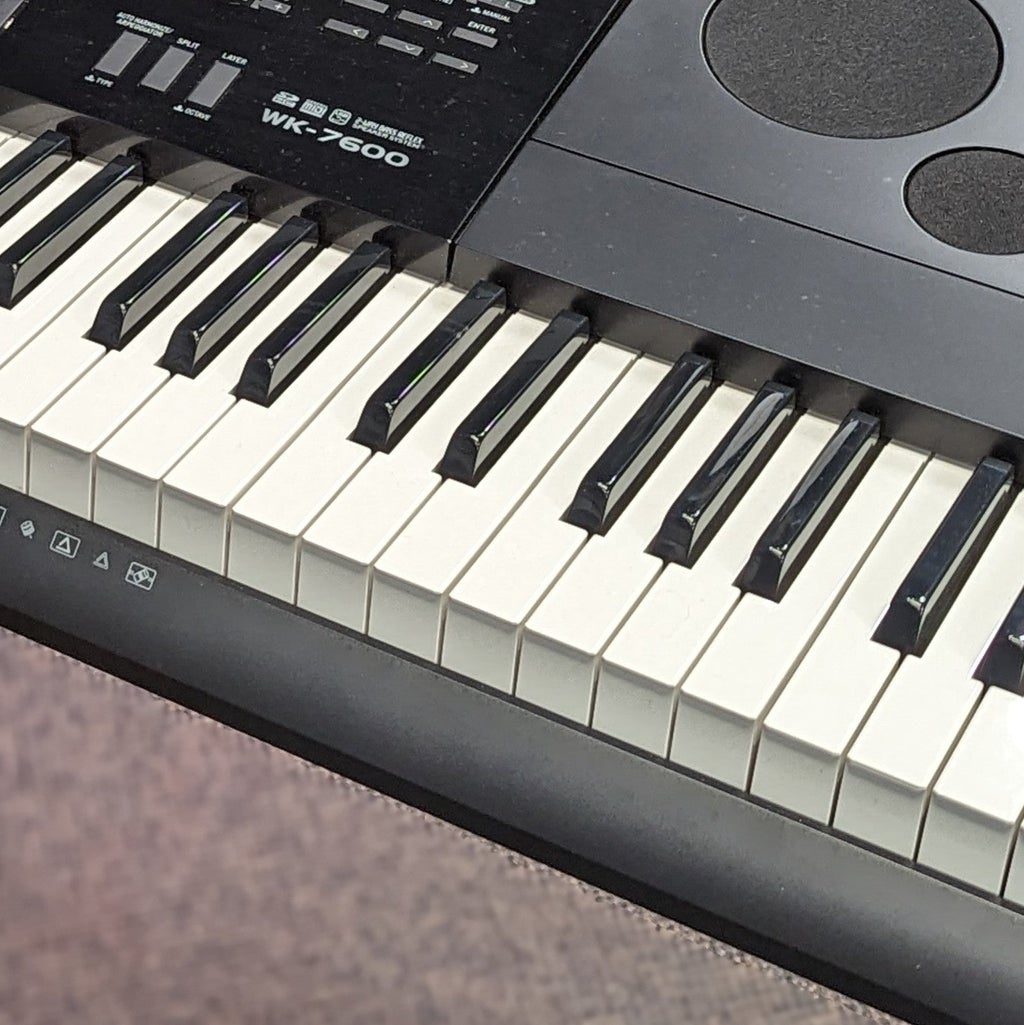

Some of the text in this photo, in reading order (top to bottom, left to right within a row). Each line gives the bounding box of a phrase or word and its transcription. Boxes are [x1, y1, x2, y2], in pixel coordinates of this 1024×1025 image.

[482, 9, 511, 23] MANUAL
[467, 21, 496, 35] ENTER
[176, 37, 200, 50] SPLIT
[222, 52, 248, 66] LAYER
[95, 77, 114, 88] TYPE
[184, 107, 211, 122] OCTAVE
[261, 107, 410, 167] WK-7600
